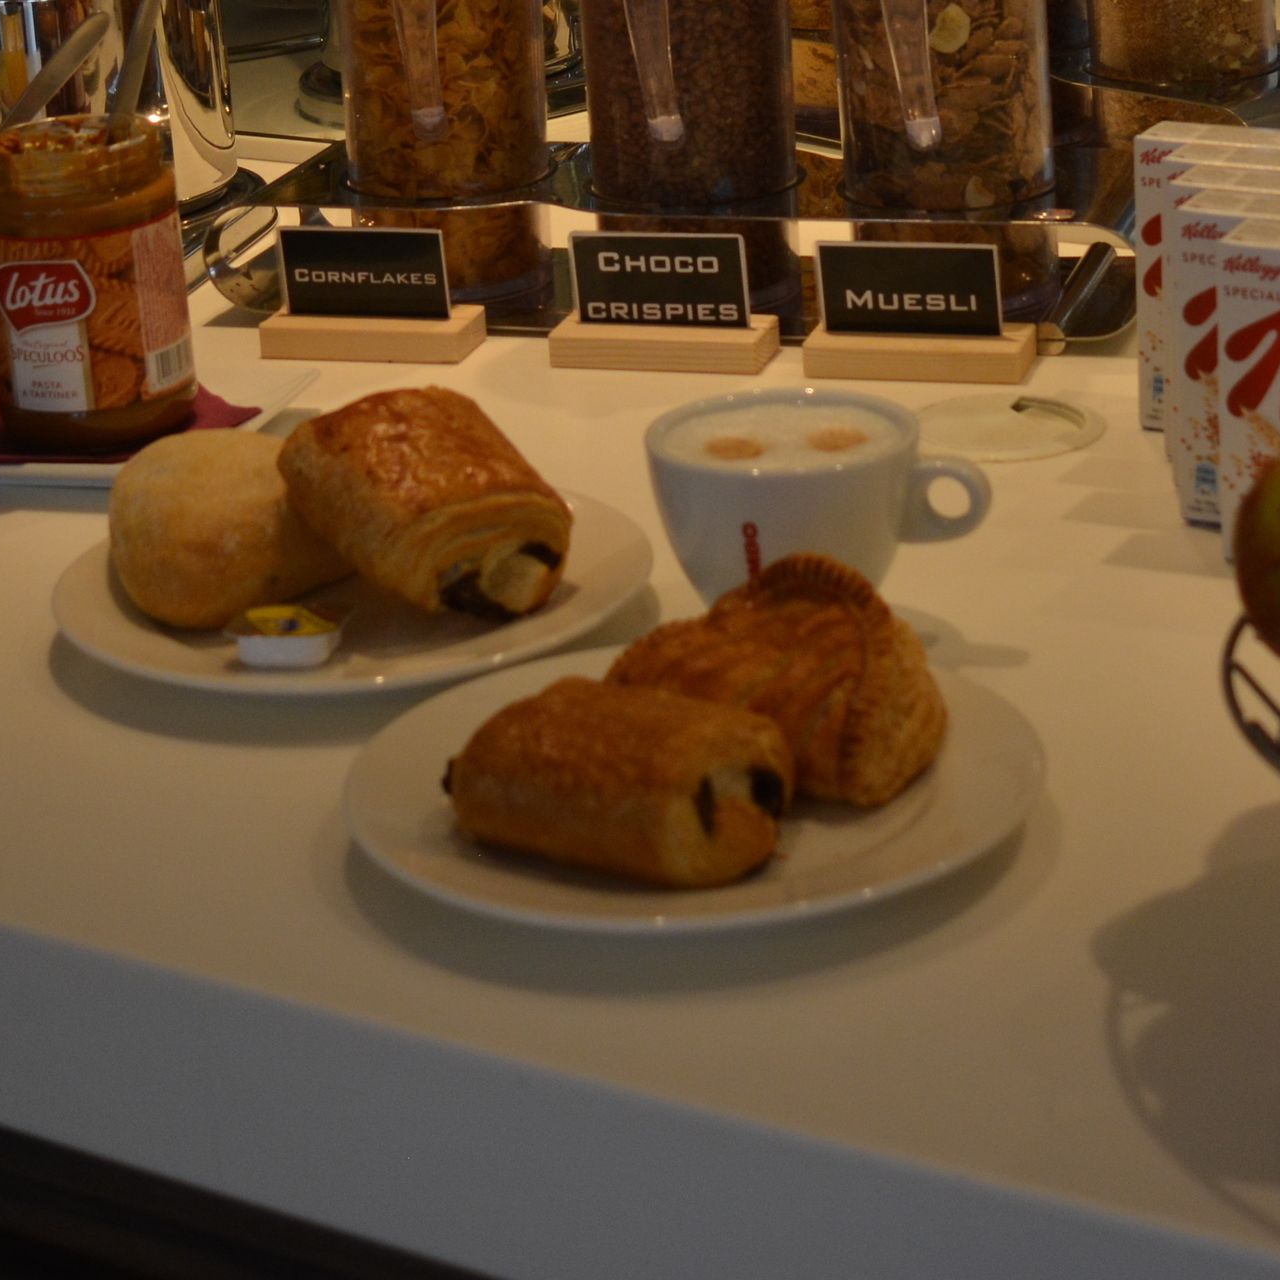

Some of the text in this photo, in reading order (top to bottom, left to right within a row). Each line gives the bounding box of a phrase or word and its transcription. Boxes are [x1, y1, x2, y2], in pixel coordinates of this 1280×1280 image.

[597, 251, 719, 273] CHOCO
[294, 269, 437, 286] CORNFLAKES
[587, 301, 739, 321] CRISPIES
[845, 289, 977, 312] MUESLI
